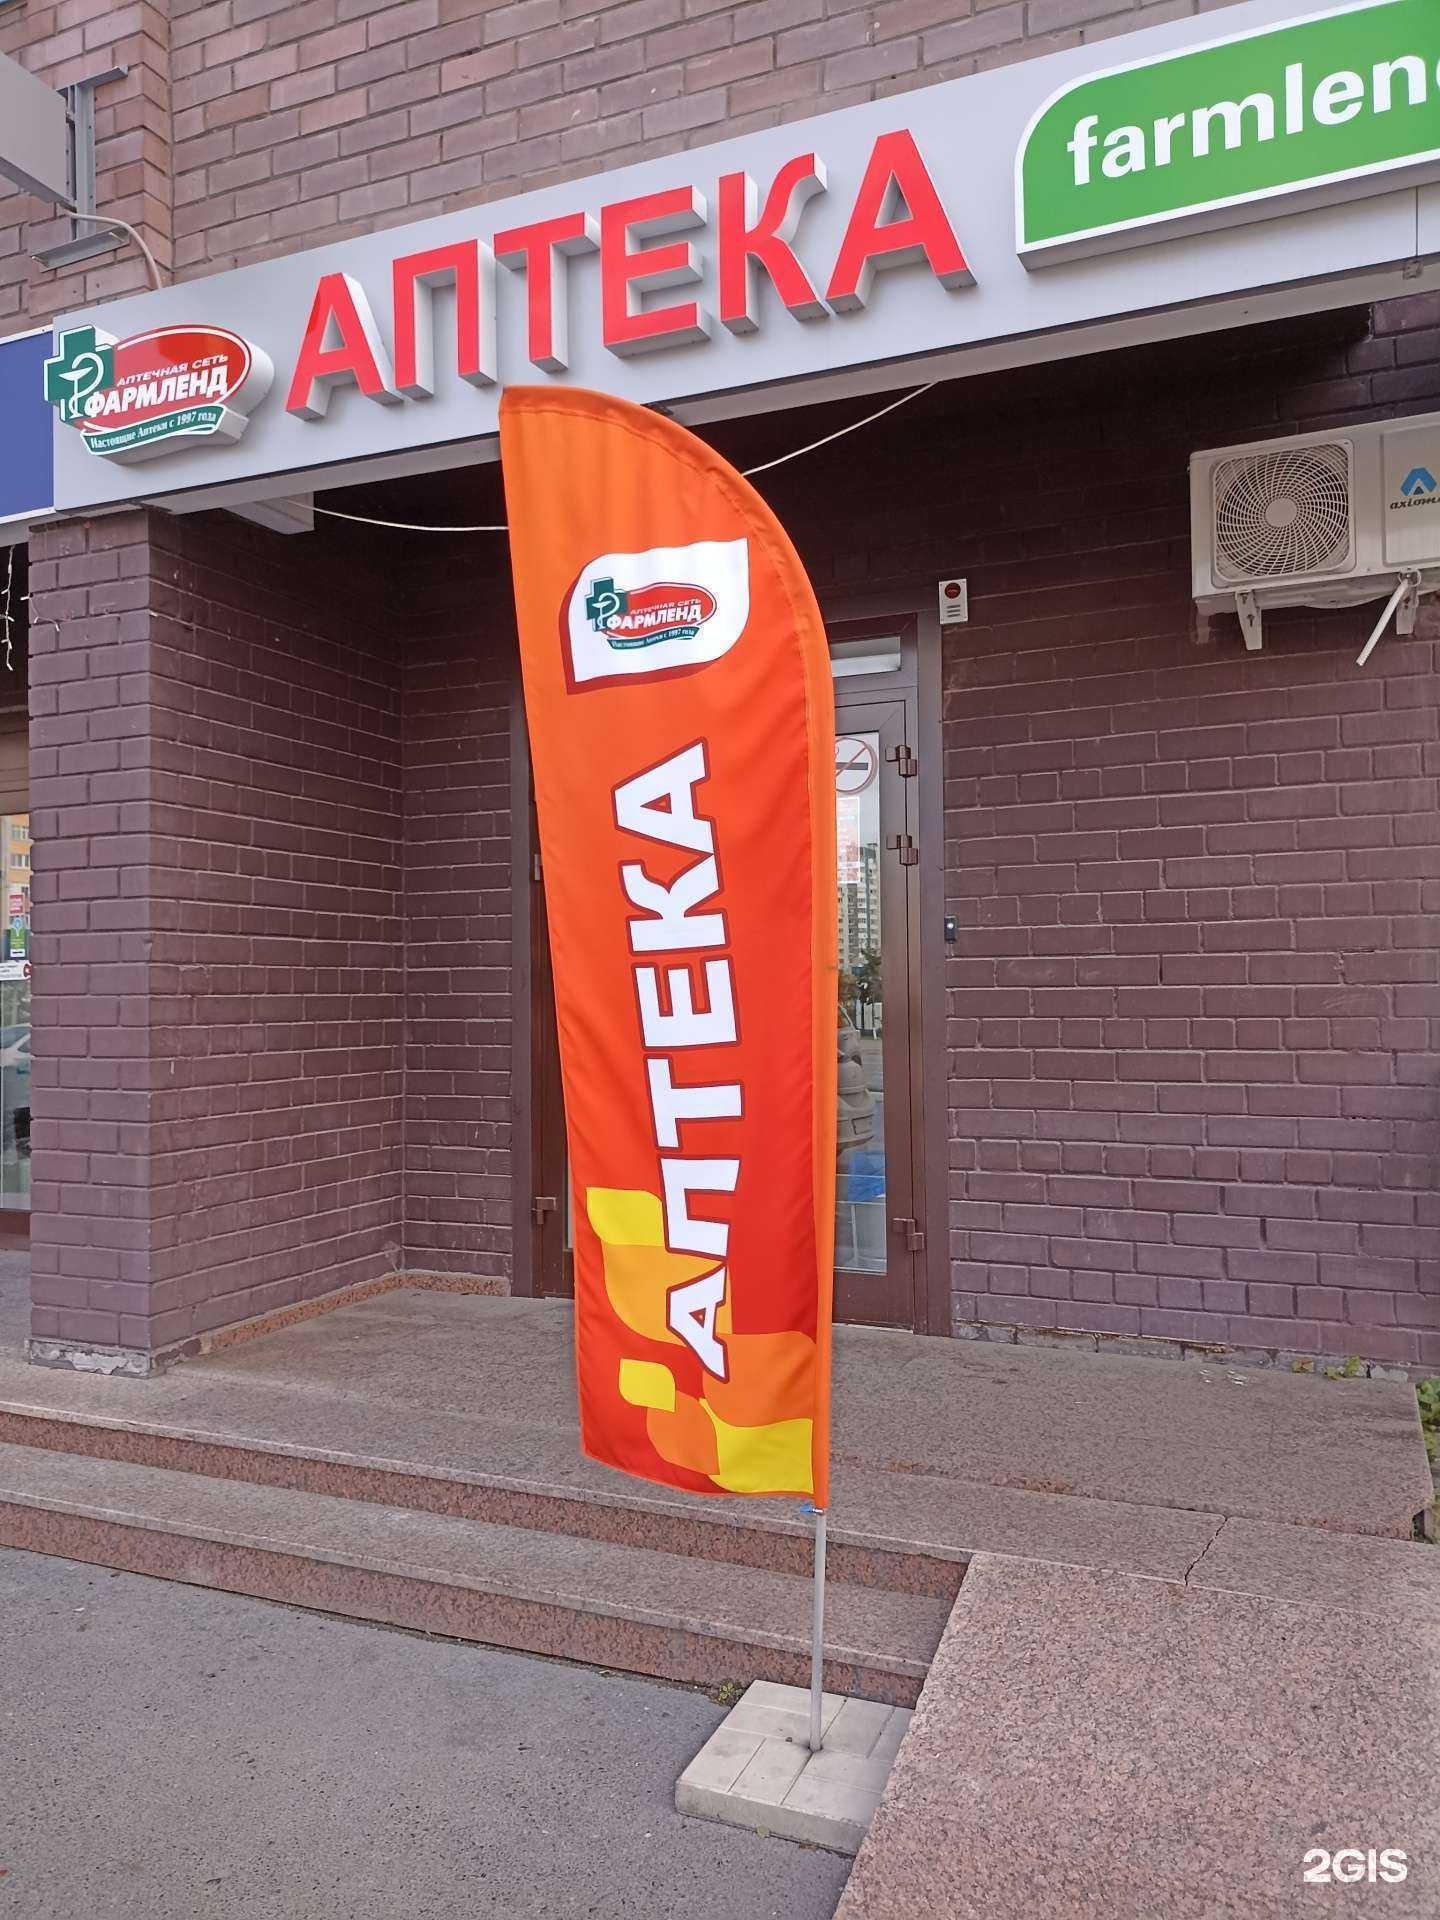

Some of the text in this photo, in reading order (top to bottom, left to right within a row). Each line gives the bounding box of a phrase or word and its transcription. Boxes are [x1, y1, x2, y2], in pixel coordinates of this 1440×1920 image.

[1067, 55, 1440, 186] farmlen
[285, 128, 970, 416] АПТЕКА
[84, 365, 228, 418] ФАРМЛЕНД
[117, 354, 228, 387] АПТЕЧНАЯ СЕТЬ
[90, 432, 136, 449] Настоящие
[137, 420, 168, 438] Аптеки
[177, 411, 197, 427] 1997
[197, 412, 217, 423] года
[606, 604, 702, 630] ФАРМЛЕНД
[613, 738, 743, 1383] АПТЕКА
